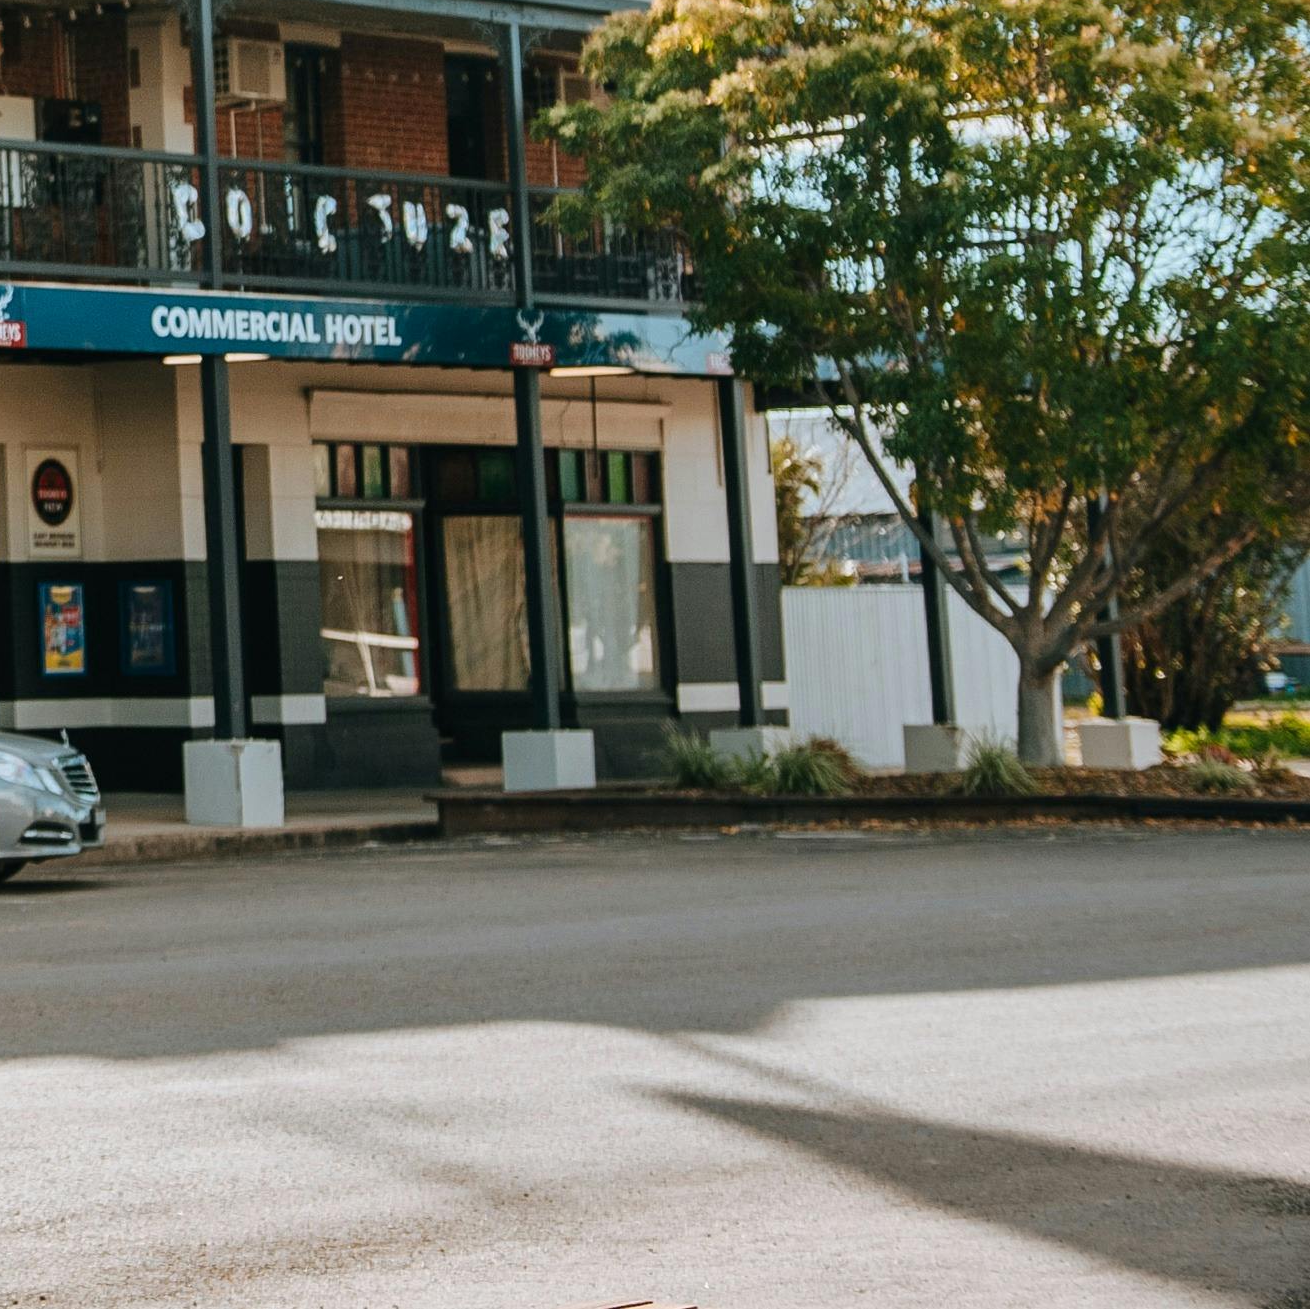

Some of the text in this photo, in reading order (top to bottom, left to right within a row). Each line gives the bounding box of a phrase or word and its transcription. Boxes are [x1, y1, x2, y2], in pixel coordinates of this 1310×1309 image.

[150, 305, 403, 347] COMMERCIAL HOTEL
[512, 343, 552, 362] TOOHEYS
